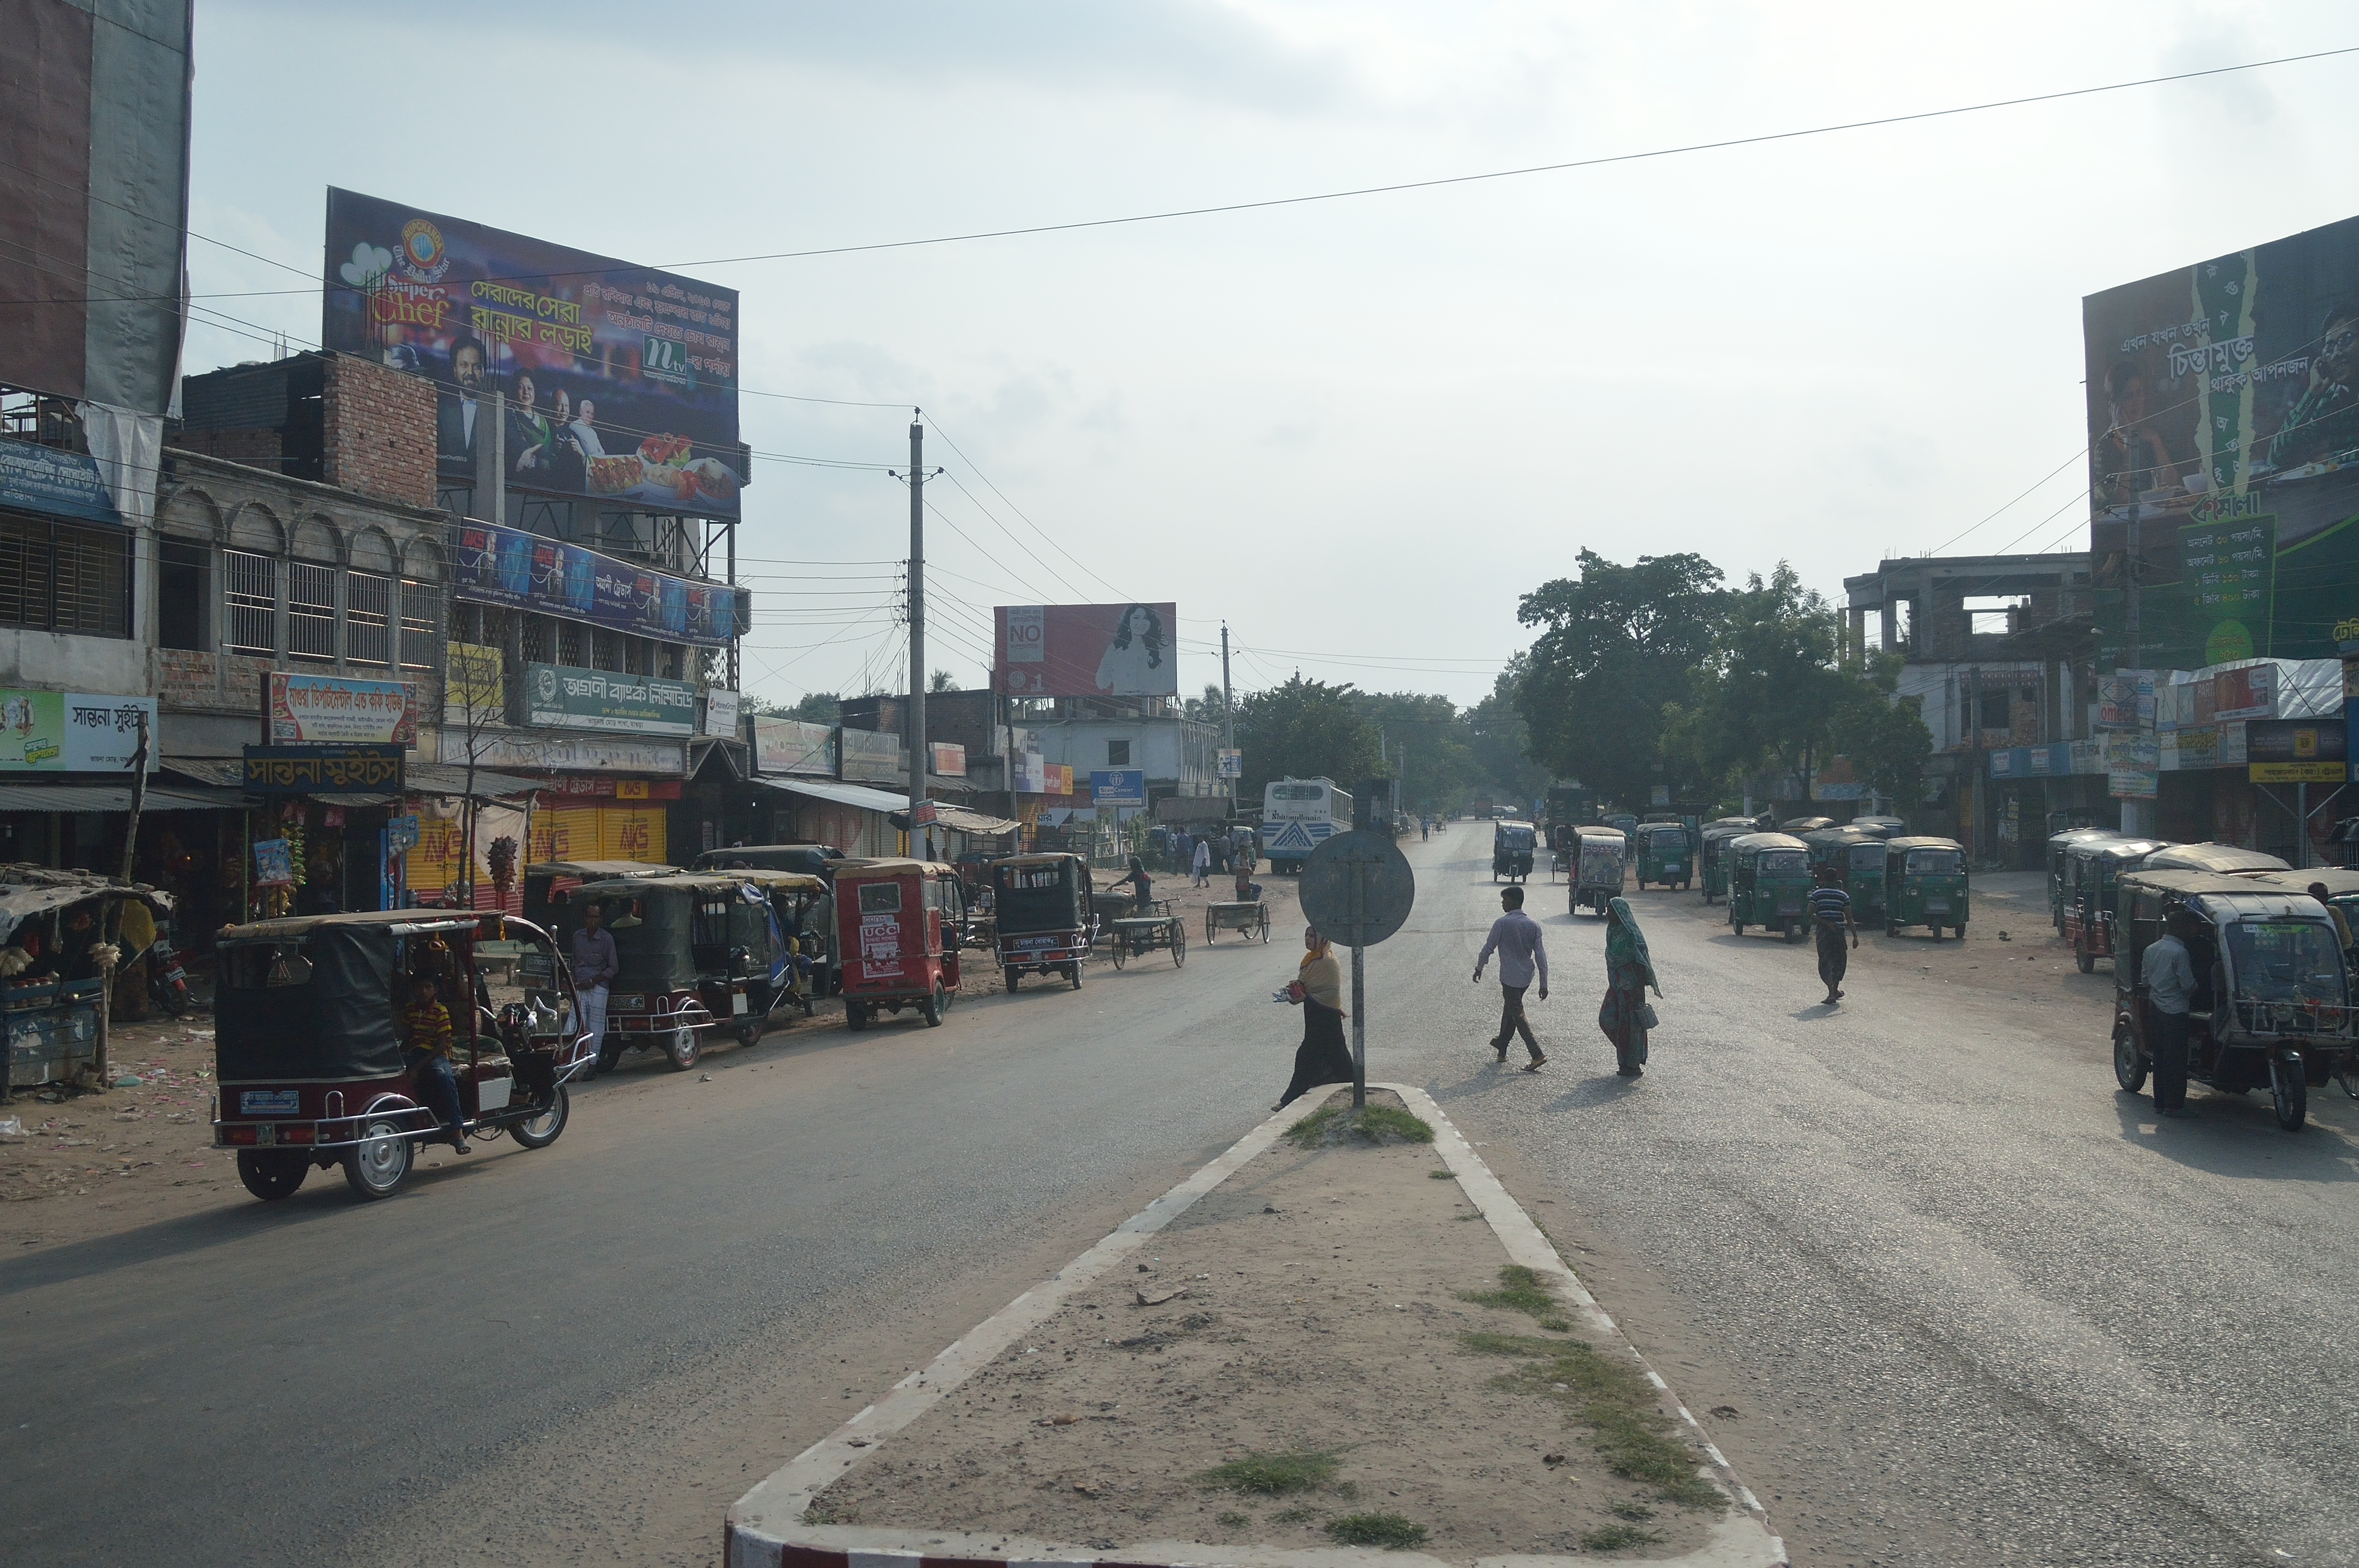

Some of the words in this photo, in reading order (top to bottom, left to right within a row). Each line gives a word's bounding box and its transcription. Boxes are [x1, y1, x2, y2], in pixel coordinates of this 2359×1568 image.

[404, 221, 443, 251] RUPCHANDA
[388, 275, 445, 301] Super
[687, 292, 711, 307] ২০১৫
[373, 292, 449, 328] Chef
[470, 281, 535, 310] সেরাদের
[536, 296, 581, 324] সেরা
[602, 287, 633, 306] রবিবার
[634, 296, 653, 313] এবং
[690, 309, 707, 323] রাত
[470, 306, 533, 344] রান্নার
[538, 321, 593, 355] লড়াই
[654, 322, 683, 339] দেখতে
[685, 329, 705, 344] চোখ
[706, 334, 730, 353] রাখুন
[2121, 334, 2147, 353] এখন
[2151, 326, 2177, 346] যখন
[2181, 317, 2211, 337] তখন
[2167, 333, 2255, 380] চিন্তামুক্ত
[2211, 372, 2248, 394] থাকুক
[2251, 356, 2310, 383] আপনজন
[2187, 535, 2213, 547] অননেট
[2187, 554, 2214, 567] অফনেট
[2217, 555, 2229, 564] ৬০
[2202, 573, 2220, 585] জিবি
[2202, 593, 2219, 605] জিবি
[2242, 590, 2260, 600] টাকা
[1010, 625, 1041, 642] NO
[563, 676, 607, 698] অগ্রণী
[609, 683, 647, 703] ব্যাংক
[864, 926, 897, 937] UCC
